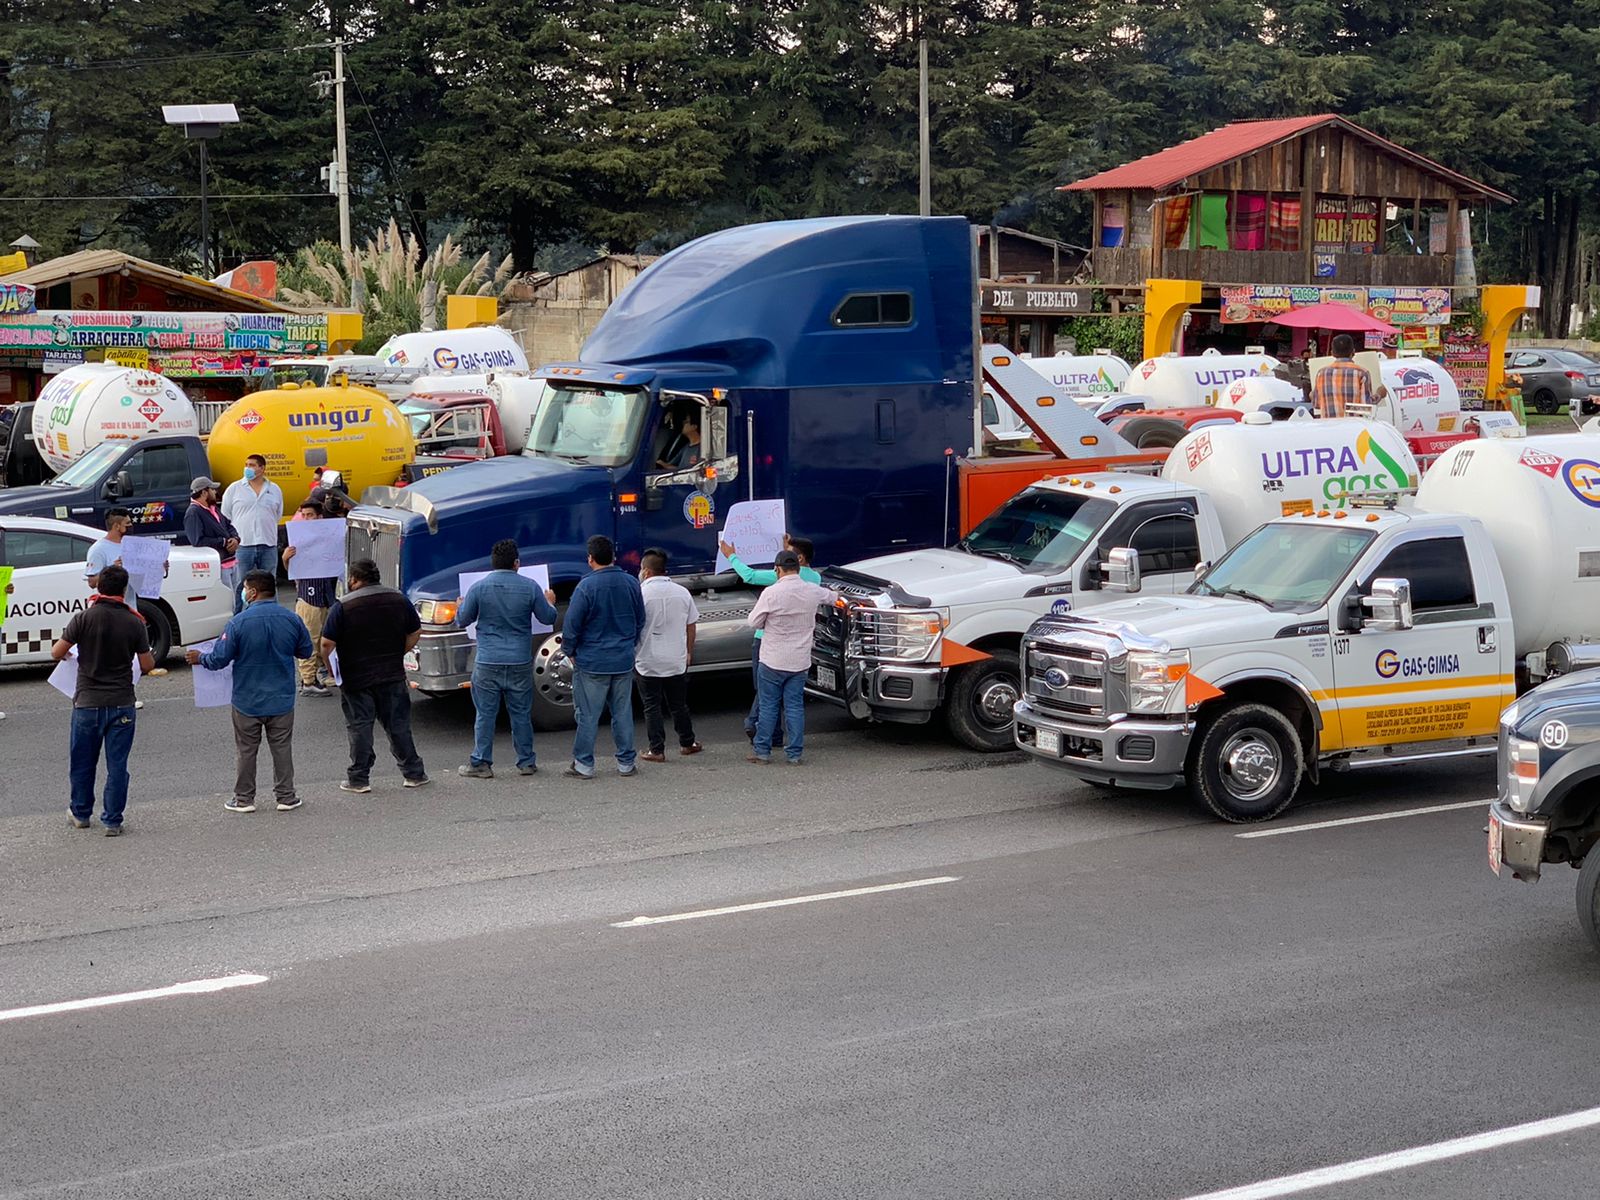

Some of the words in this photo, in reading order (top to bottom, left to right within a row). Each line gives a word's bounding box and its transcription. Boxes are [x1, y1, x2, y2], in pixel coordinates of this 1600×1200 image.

[993, 290, 1014, 306] DEL
[1026, 291, 1078, 307] PUEBLITO
[72, 313, 132, 327] QUESADILLAS
[240, 315, 285, 330] HUARACHES
[71, 331, 144, 347] ARRACHERA
[159, 333, 190, 348] CARNE
[194, 333, 225, 348] ASADA
[229, 334, 270, 349] TRUCHA
[45, 351, 82, 360] TARJETAS
[461, 350, 515, 370] GAS-GIMSA
[1053, 373, 1100, 386] ULTRA
[1088, 383, 1109, 395] gas
[1395, 381, 1439, 403] padilla
[239, 415, 259, 424] 1075
[288, 408, 373, 432] unigas
[1262, 446, 1359, 479] ULTRA
[1450, 450, 1475, 477] 1377
[1526, 455, 1556, 466] 1075
[308, 586, 316, 597] 3
[1334, 638, 1350, 655] 1377
[1402, 654, 1460, 677] GAS-GIMSA
[1543, 725, 1565, 745] 90
